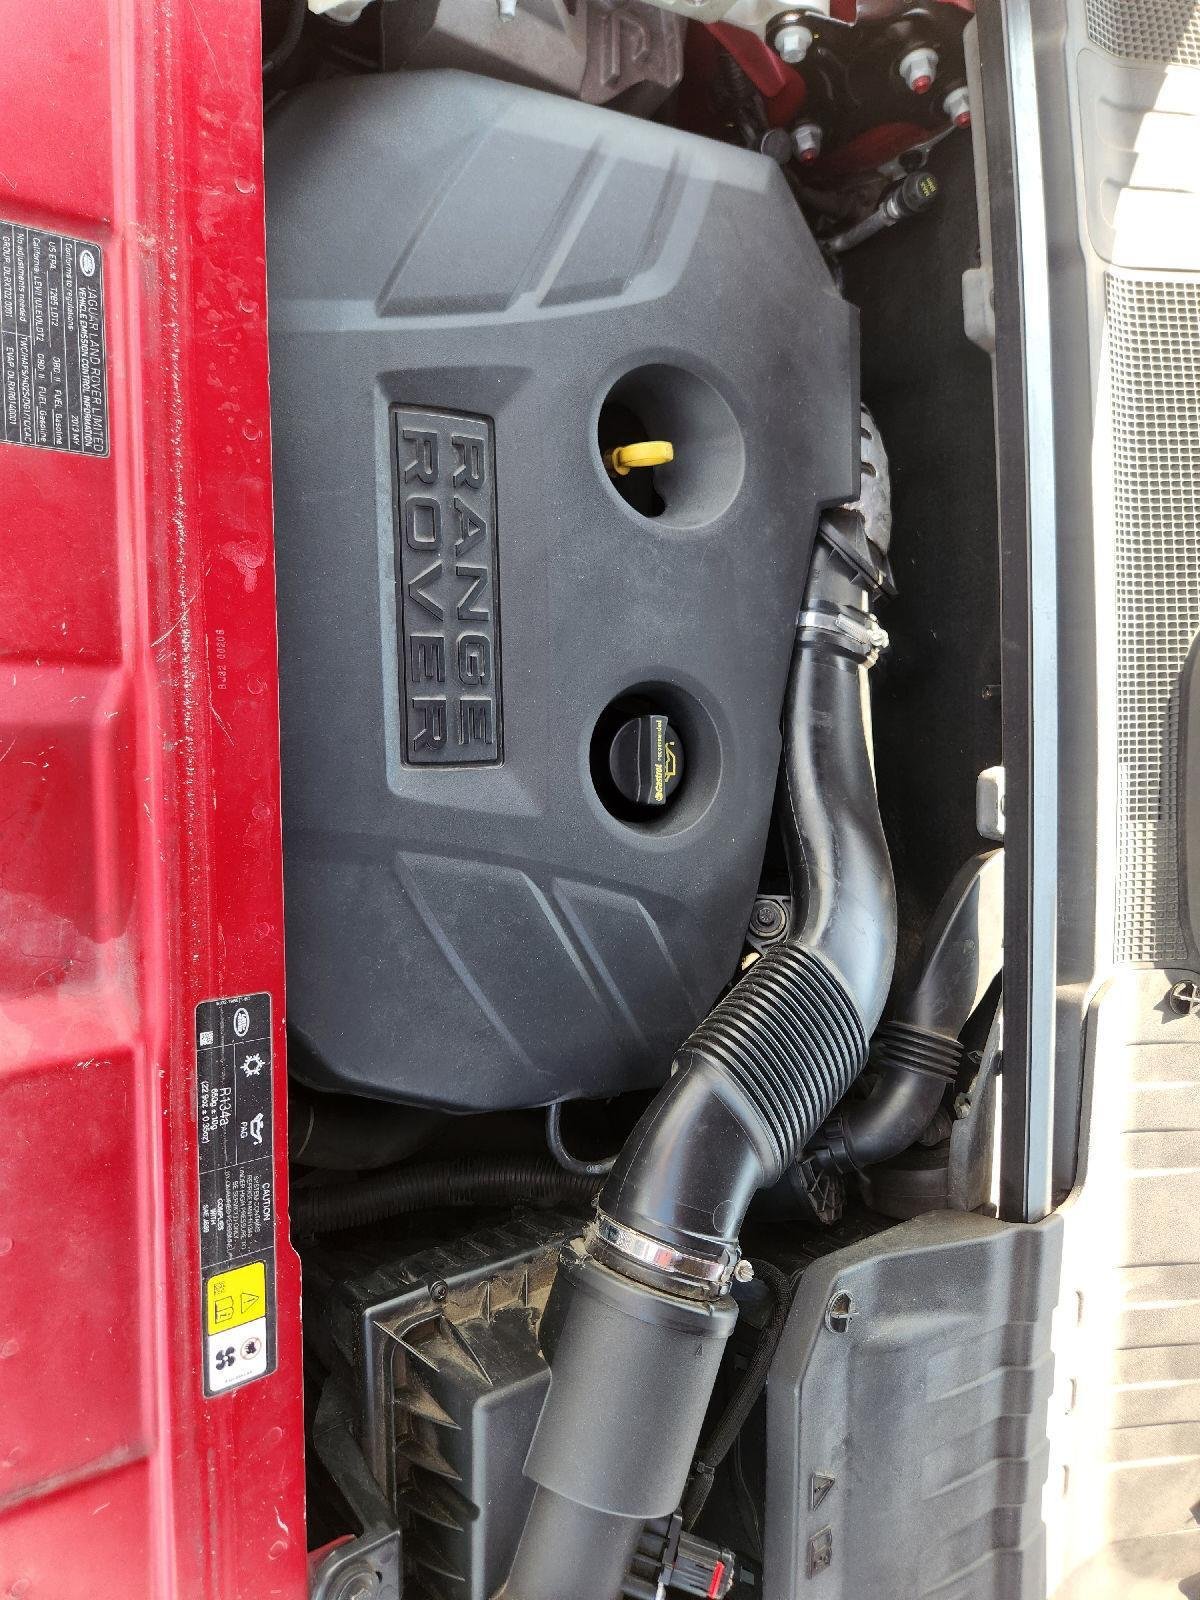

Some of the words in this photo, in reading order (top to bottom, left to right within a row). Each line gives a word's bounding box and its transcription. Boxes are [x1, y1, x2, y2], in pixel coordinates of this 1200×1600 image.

[49, 242, 56, 252] US
[65, 243, 73, 278] Conforms
[16, 246, 25, 292] adjustments
[19, 294, 27, 322] needed
[79, 287, 87, 318] VEHICLE
[88, 286, 98, 330] JAGUAR
[80, 321, 88, 356] EMISSION
[89, 334, 100, 364] LAND
[81, 359, 90, 393] CONTROL
[91, 368, 101, 404] ROVER
[39, 410, 47, 442] Gasoline
[55, 414, 63, 445] Gasoline
[83, 395, 92, 446] INFORMATION
[92, 408, 103, 452] LIMITED
[72, 434, 79, 445] MY
[403, 429, 448, 752] ROVER
[452, 434, 494, 745] RANGE
[219, 1087, 231, 1126] R134a
[240, 1122, 248, 1139] PAG
[262, 1183, 270, 1221] CAUTION
